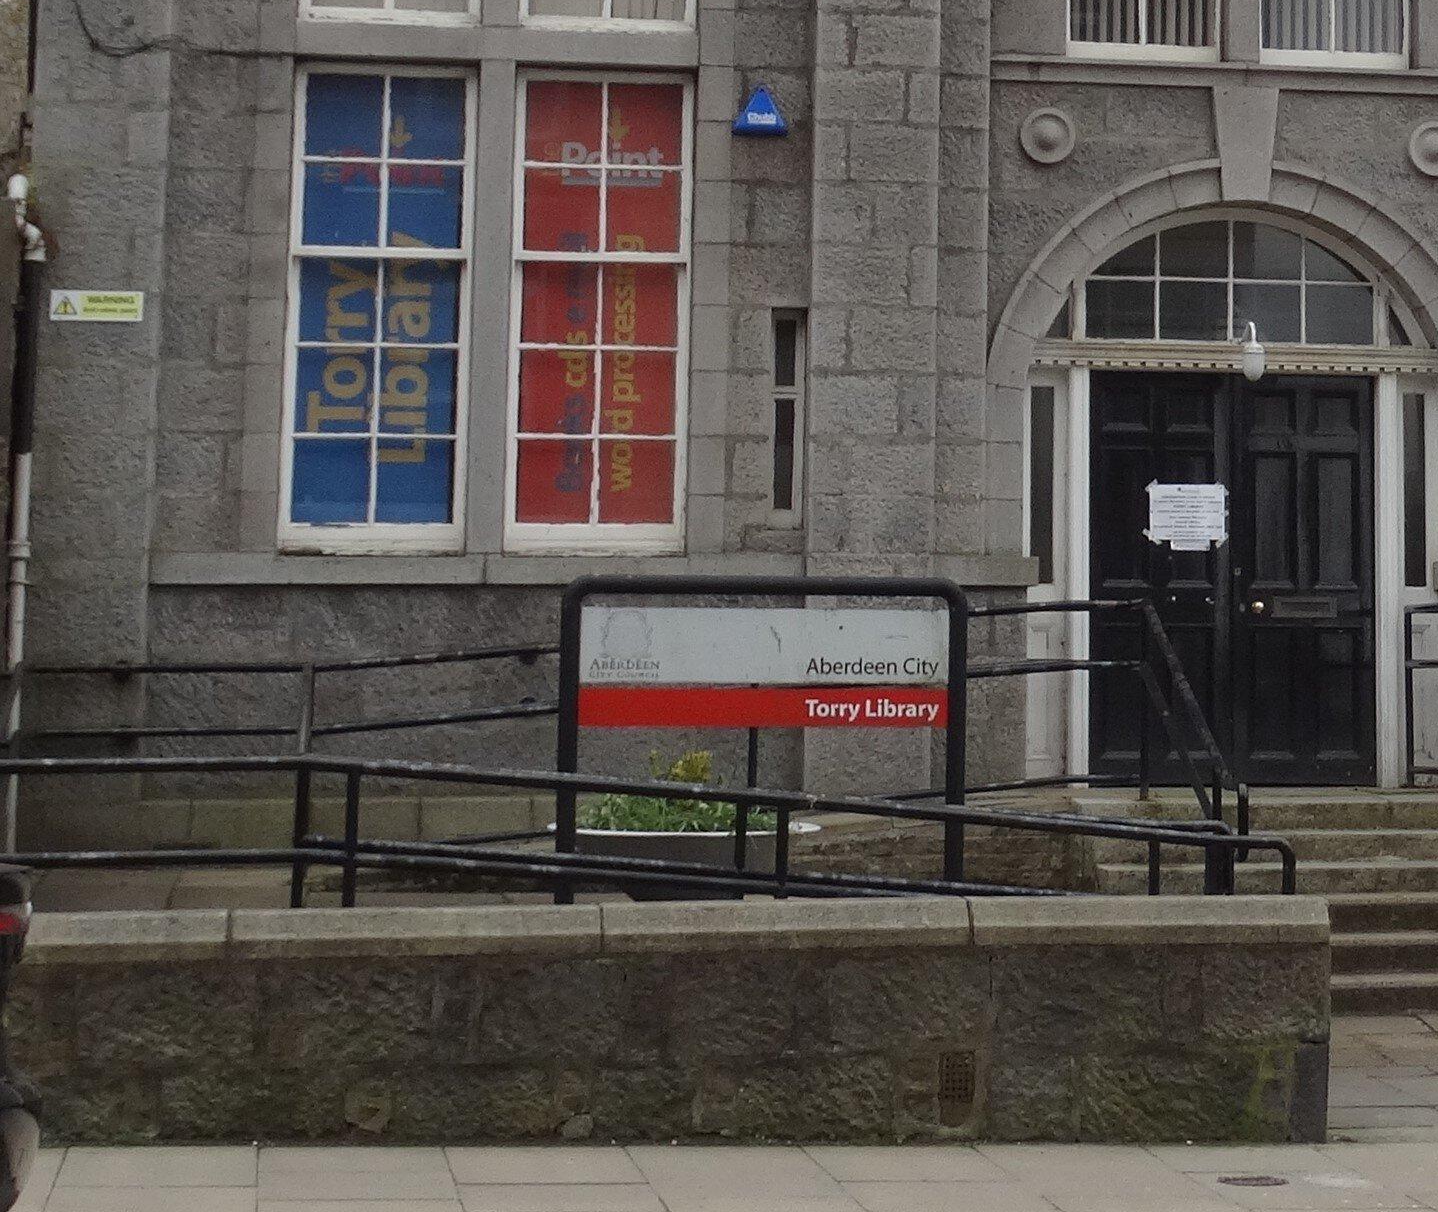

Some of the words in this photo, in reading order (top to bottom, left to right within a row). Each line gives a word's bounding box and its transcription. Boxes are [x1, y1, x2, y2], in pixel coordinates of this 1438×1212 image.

[307, 260, 384, 434] Torry
[373, 231, 447, 463] Library
[600, 408, 633, 491] wod
[806, 656, 897, 675] Aberdeen
[902, 657, 939, 678] City
[805, 699, 860, 721] Torry
[865, 699, 939, 721] Library
